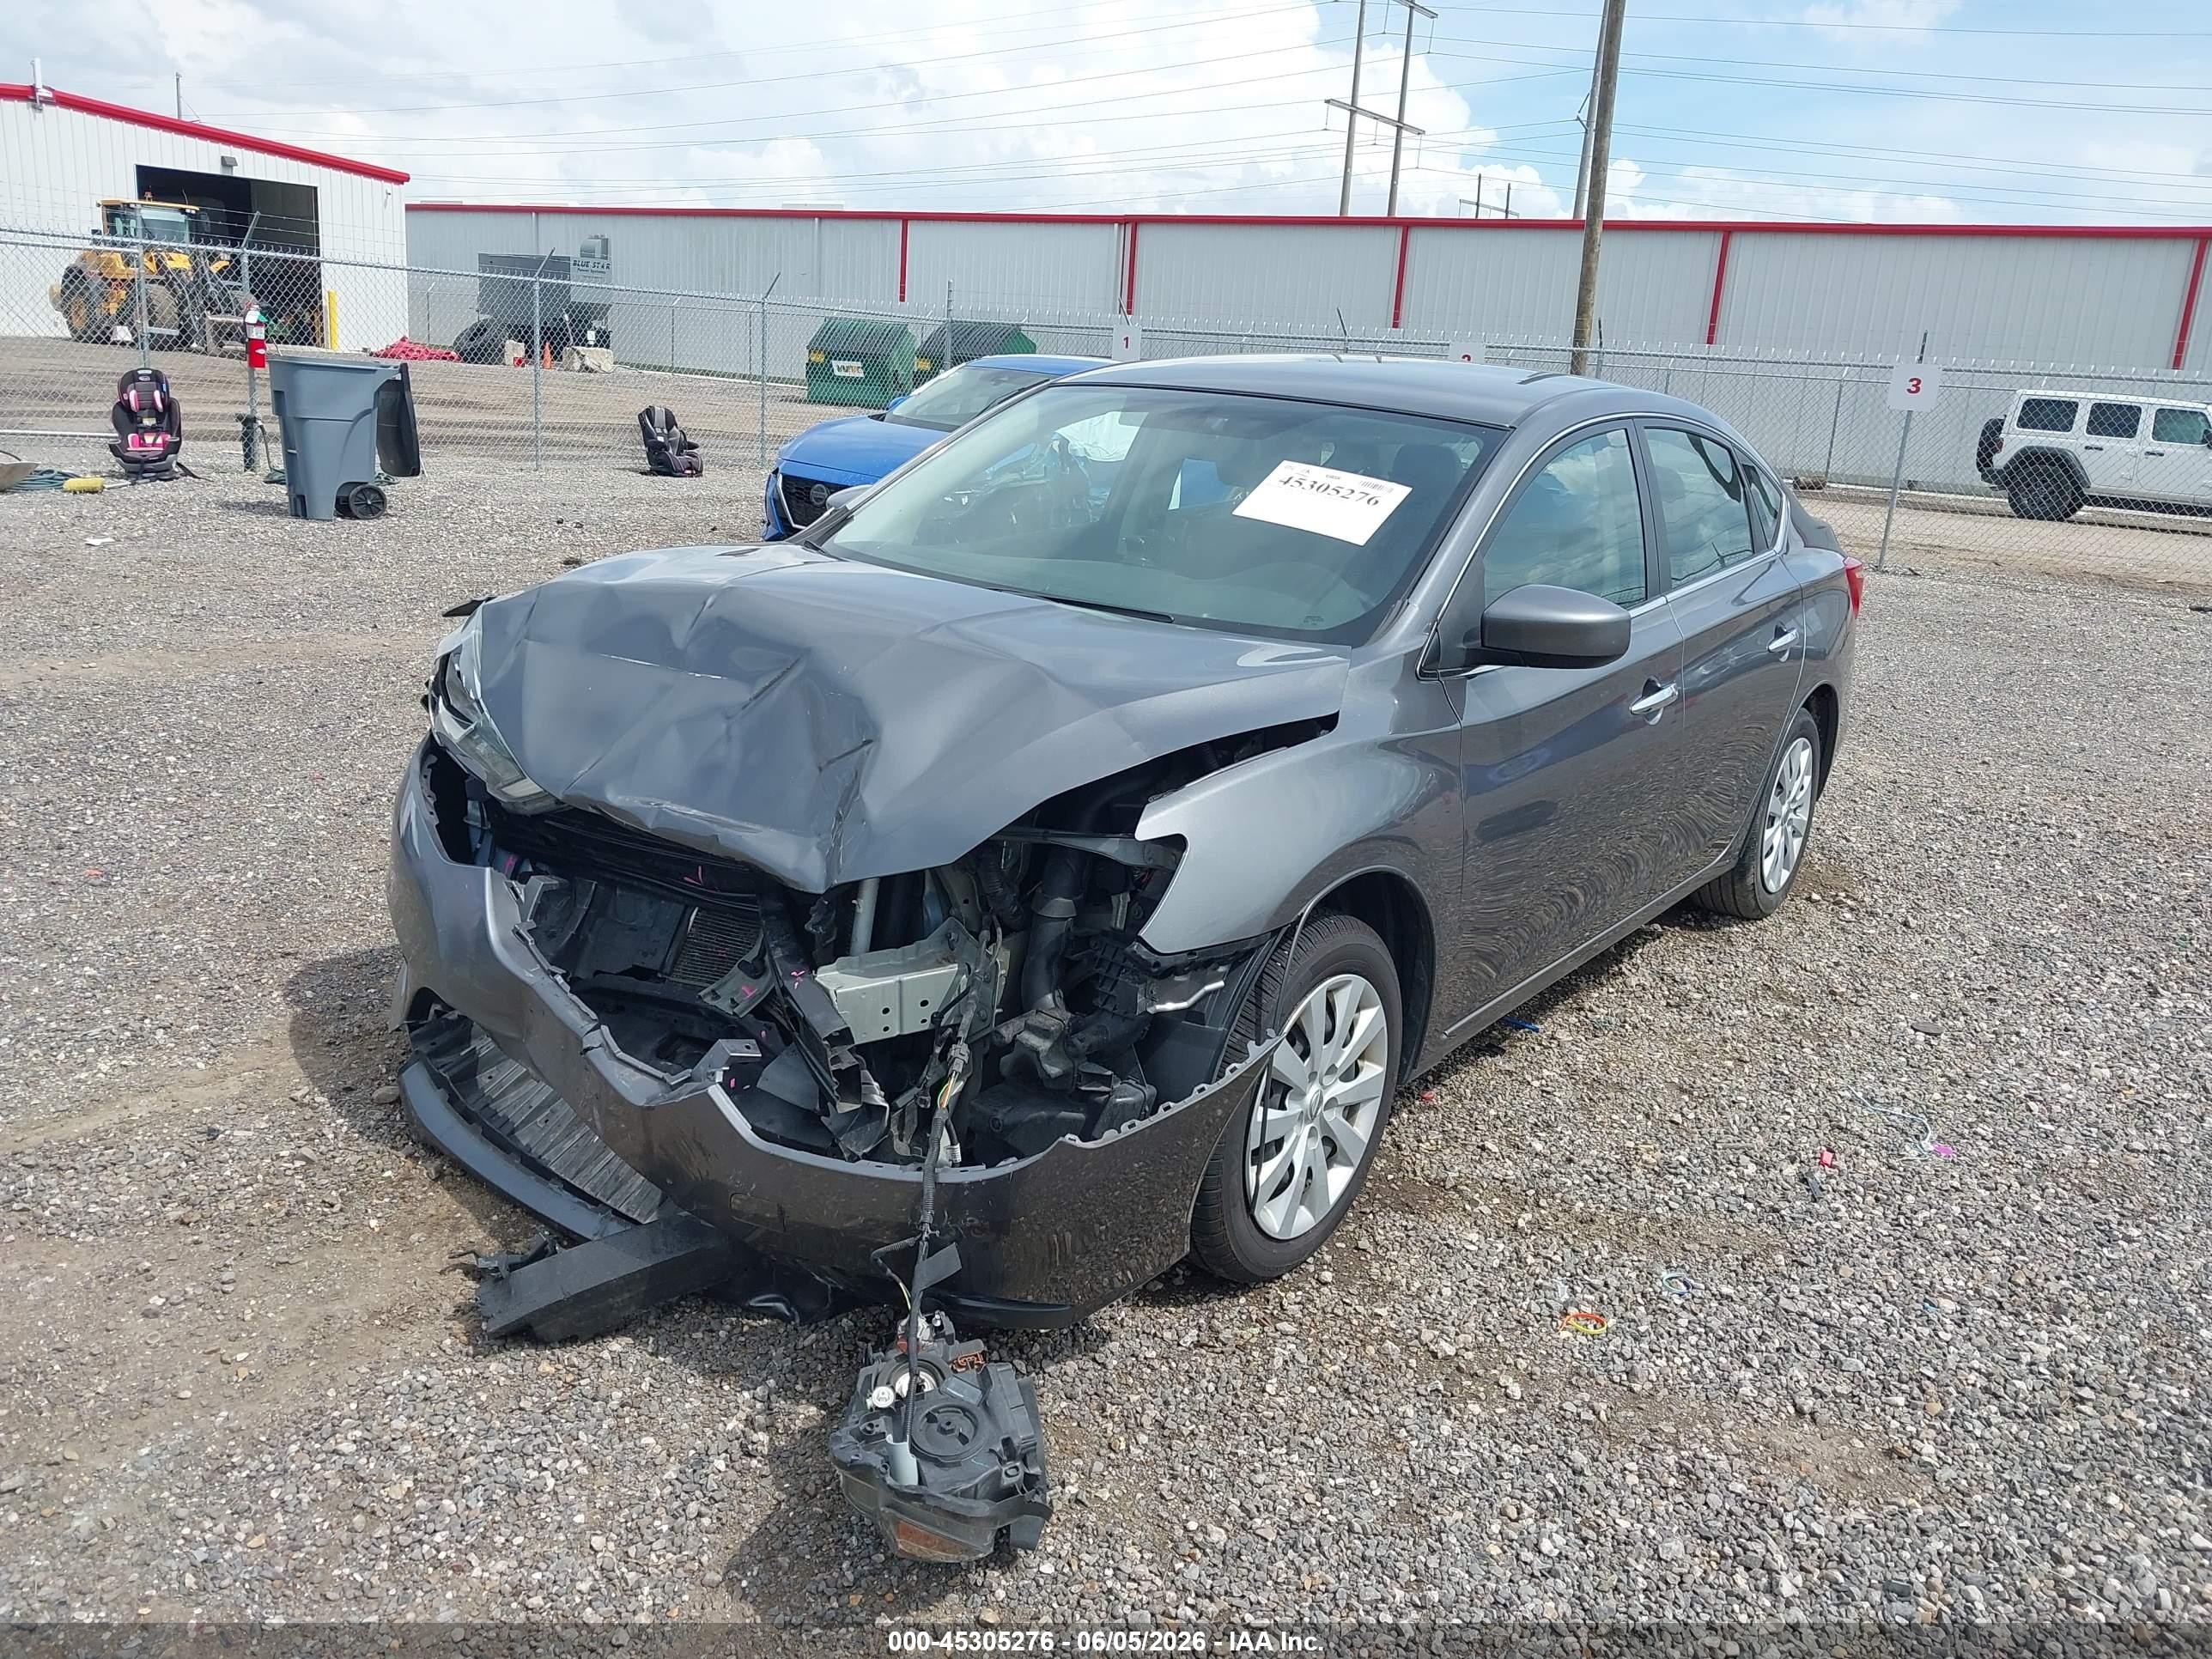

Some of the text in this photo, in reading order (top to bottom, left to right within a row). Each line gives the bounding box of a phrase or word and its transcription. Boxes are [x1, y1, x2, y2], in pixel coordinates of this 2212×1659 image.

[573, 259, 611, 270] BLUE STAR
[1123, 336, 1129, 349] 1
[1906, 377, 1922, 394] 3
[1279, 476, 1382, 506] 45305276
